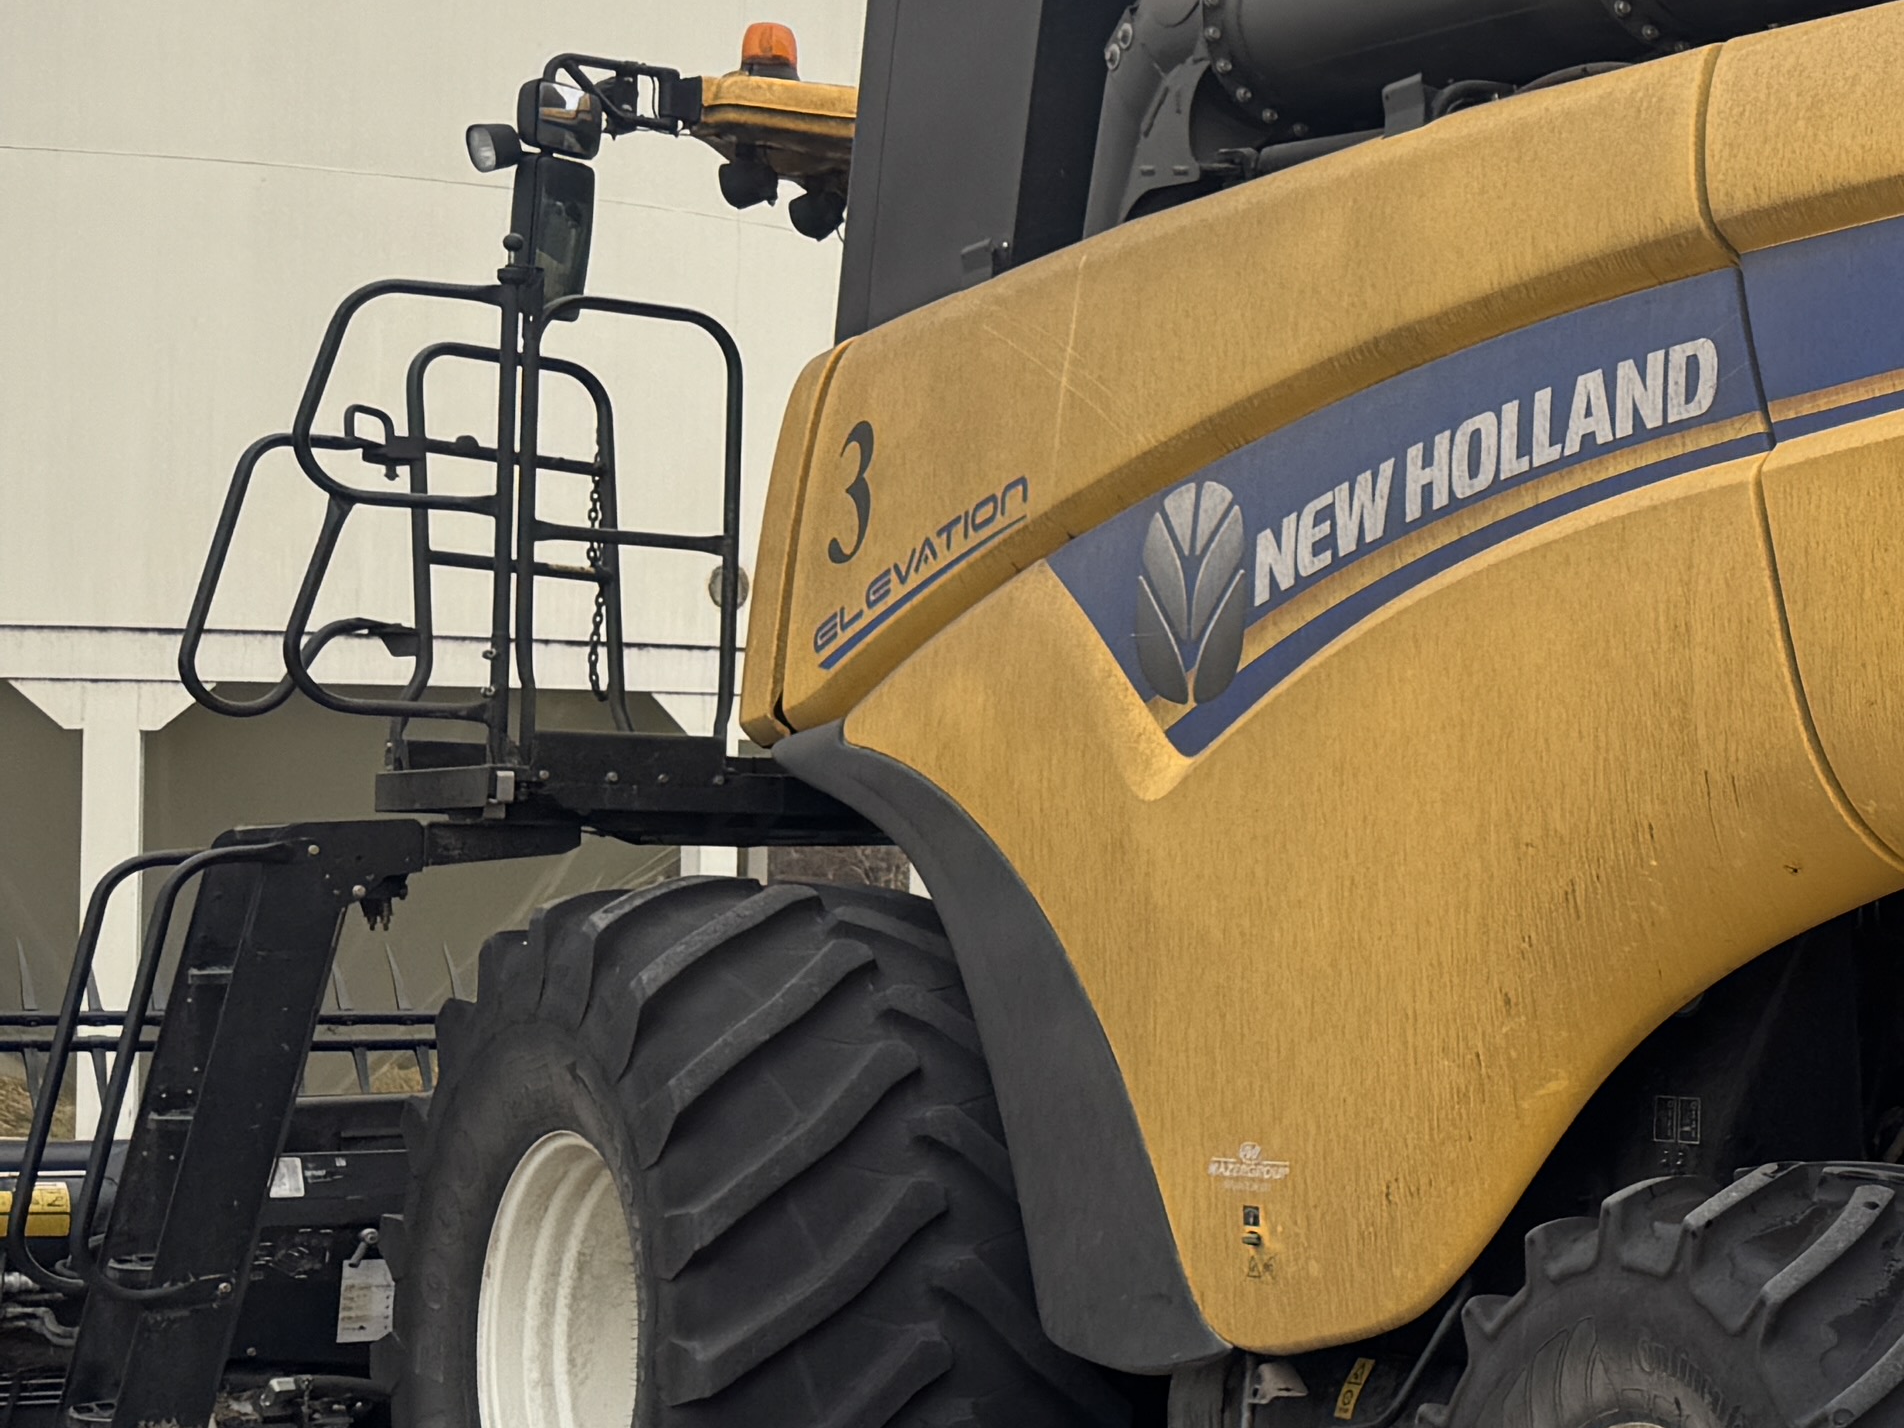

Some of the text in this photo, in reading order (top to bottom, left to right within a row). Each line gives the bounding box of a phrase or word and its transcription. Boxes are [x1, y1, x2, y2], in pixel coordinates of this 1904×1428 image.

[828, 420, 874, 564] 3
[1254, 338, 1718, 607] NEW HOLLAND
[813, 475, 1028, 653] ELEVATION
